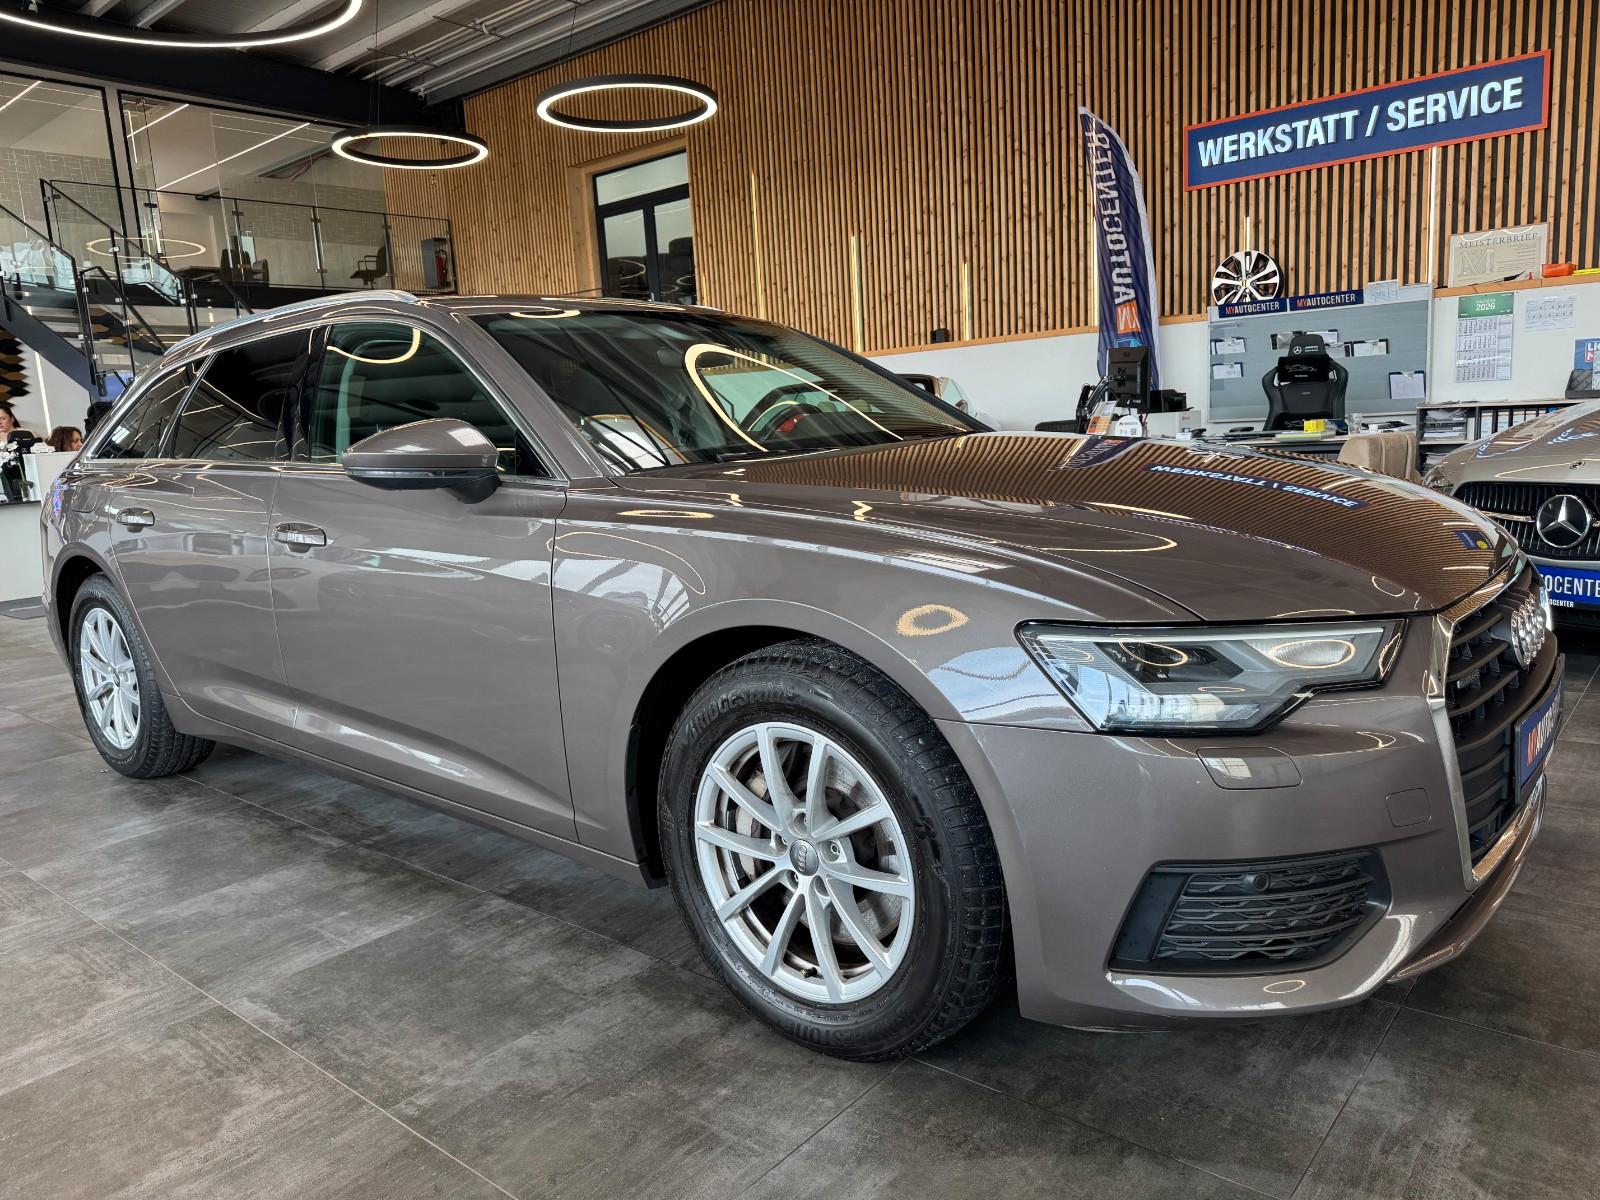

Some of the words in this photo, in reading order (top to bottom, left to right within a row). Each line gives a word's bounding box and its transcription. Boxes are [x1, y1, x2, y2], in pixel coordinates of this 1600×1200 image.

[1198, 109, 1359, 167] WERKSTATT
[1365, 104, 1380, 137] /
[1386, 76, 1523, 132] SERVICE
[1459, 233, 1538, 249] MEISTERBRIEF
[1225, 301, 1280, 315] MYAUTOCENTER
[1297, 293, 1356, 308] MYAUTOCENTER
[1476, 302, 1496, 311] 2026
